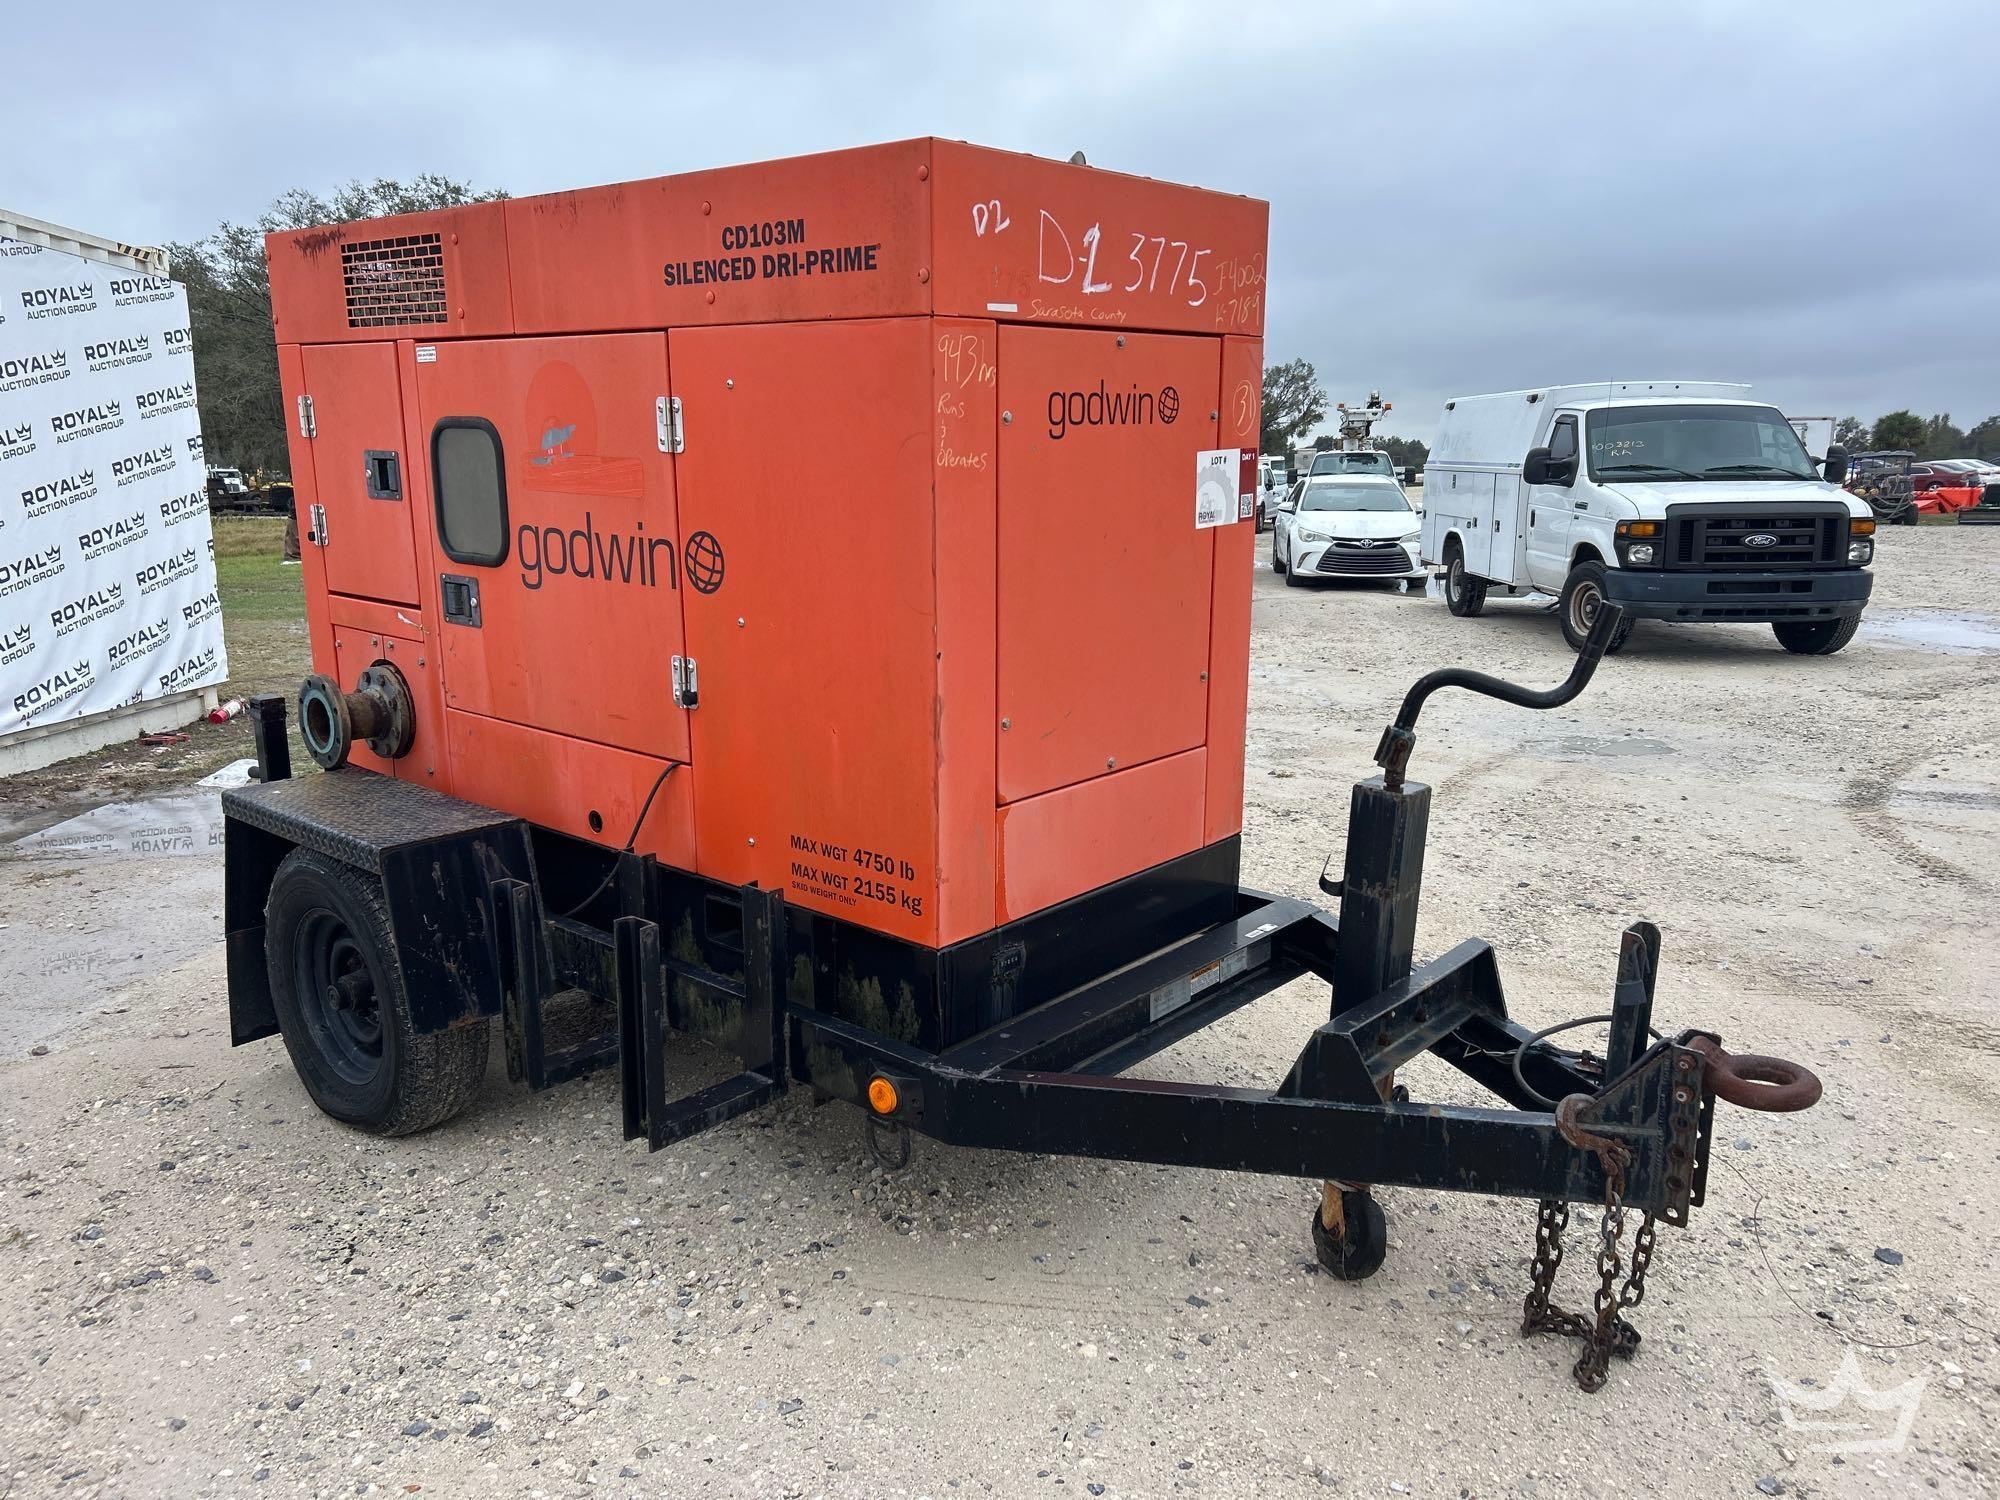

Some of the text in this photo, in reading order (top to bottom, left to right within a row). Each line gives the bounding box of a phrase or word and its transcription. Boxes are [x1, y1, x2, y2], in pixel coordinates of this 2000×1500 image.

[722, 219, 805, 250] CD103M
[664, 256, 756, 286] SILENCED
[1124, 233, 1211, 306] 3775
[21, 286, 80, 307] ROYAL
[110, 277, 160, 295] ROYAL
[115, 292, 174, 307] AUCTION GROUP
[27, 302, 97, 320] AUCTION GROUP
[1091, 307, 1127, 324] County
[84, 339, 137, 361] ROYAL
[90, 352, 152, 373] AUCTION GROUP
[40, 369, 70, 384] GROUP
[136, 386, 183, 409] ROYAL
[140, 398, 195, 420] AUCTION GROUP
[1048, 379, 1153, 439] godwin
[51, 405, 108, 432] ROYAL
[56, 418, 124, 444] AUCTION GROUP
[3, 443, 36, 460] GROUP
[112, 449, 161, 477] ROYAL
[1211, 456, 1227, 466] LOT #
[117, 460, 176, 488] AUCTION GROUP
[21, 476, 81, 508] ROYAL
[27, 487, 97, 519] AUCTION GROUP
[160, 490, 204, 518] ROYAL
[164, 510, 196, 528] AUCTION
[78, 519, 133, 551] ROYAL
[84, 528, 149, 561] AUCTION GROUP
[518, 511, 677, 589] godwin
[32, 563, 65, 583] GROUP
[136, 555, 184, 586] ROYAL
[140, 563, 199, 597] AUCTION GROUP
[51, 590, 109, 627] ROYAL
[56, 599, 125, 638] AUCTION GROUP
[187, 610, 214, 630] AUCTION
[2, 642, 36, 665] GROUP
[108, 626, 159, 661] ROYAL
[111, 633, 171, 672] AUCTION GROUP
[159, 655, 206, 690] ROYAL
[194, 661, 218, 680] GROUP
[13, 671, 78, 712] ROYAL
[20, 677, 95, 723] AUCTION GROUP
[790, 834, 915, 881] MAX WGT 4750 lb
[791, 862, 923, 917] MAX WGT 2155 kg
[791, 880, 857, 907] SKID WEIGHT ONLY
